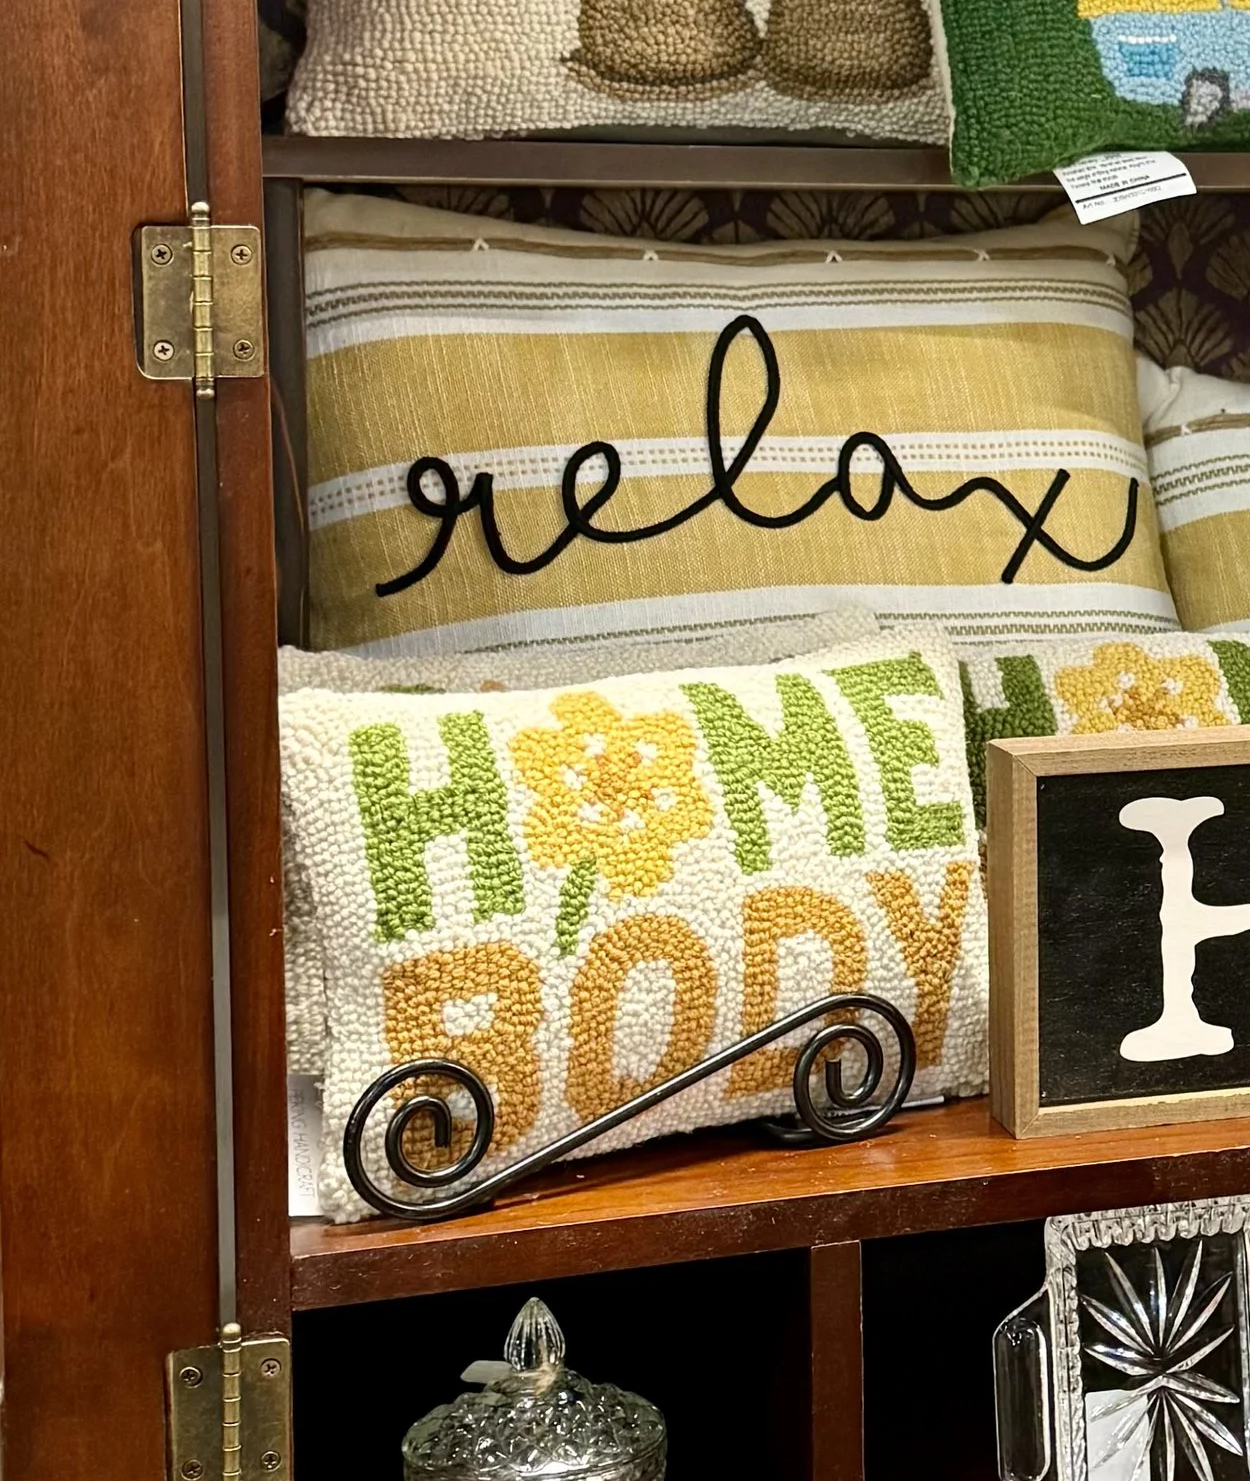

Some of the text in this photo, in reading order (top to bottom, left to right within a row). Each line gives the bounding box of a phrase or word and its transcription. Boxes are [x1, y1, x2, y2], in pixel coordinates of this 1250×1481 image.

[376, 314, 1138, 598] relax
[350, 651, 967, 943] HME
[382, 861, 975, 1168] BODY
[293, 1133, 316, 1198] HANDICRAFT
